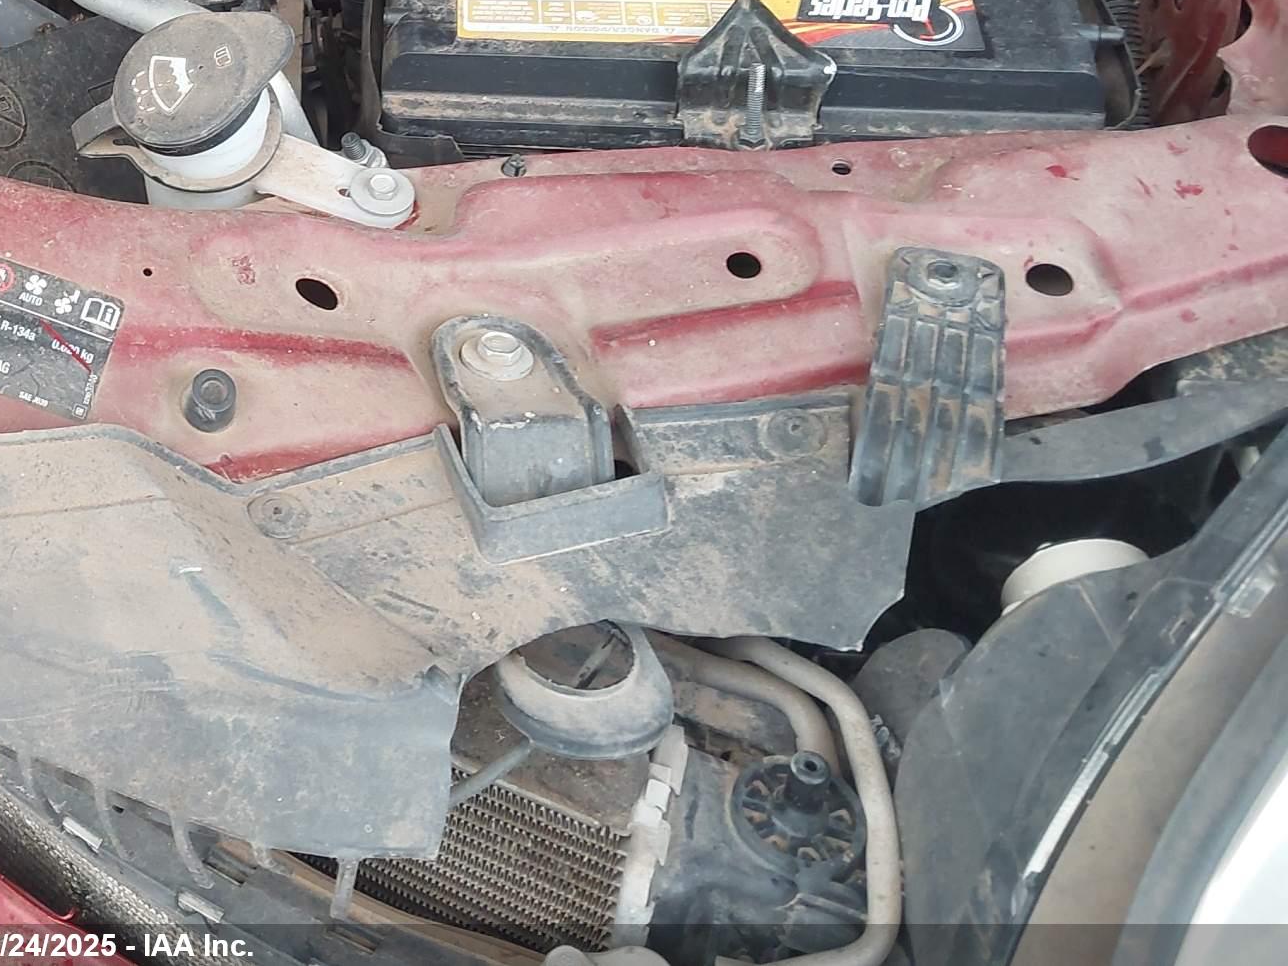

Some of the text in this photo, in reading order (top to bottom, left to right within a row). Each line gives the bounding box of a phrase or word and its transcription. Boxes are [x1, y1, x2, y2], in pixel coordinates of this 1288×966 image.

[18, 292, 43, 306] AUTO
[0, 320, 36, 341] R-134a
[80, 348, 94, 364] kg
